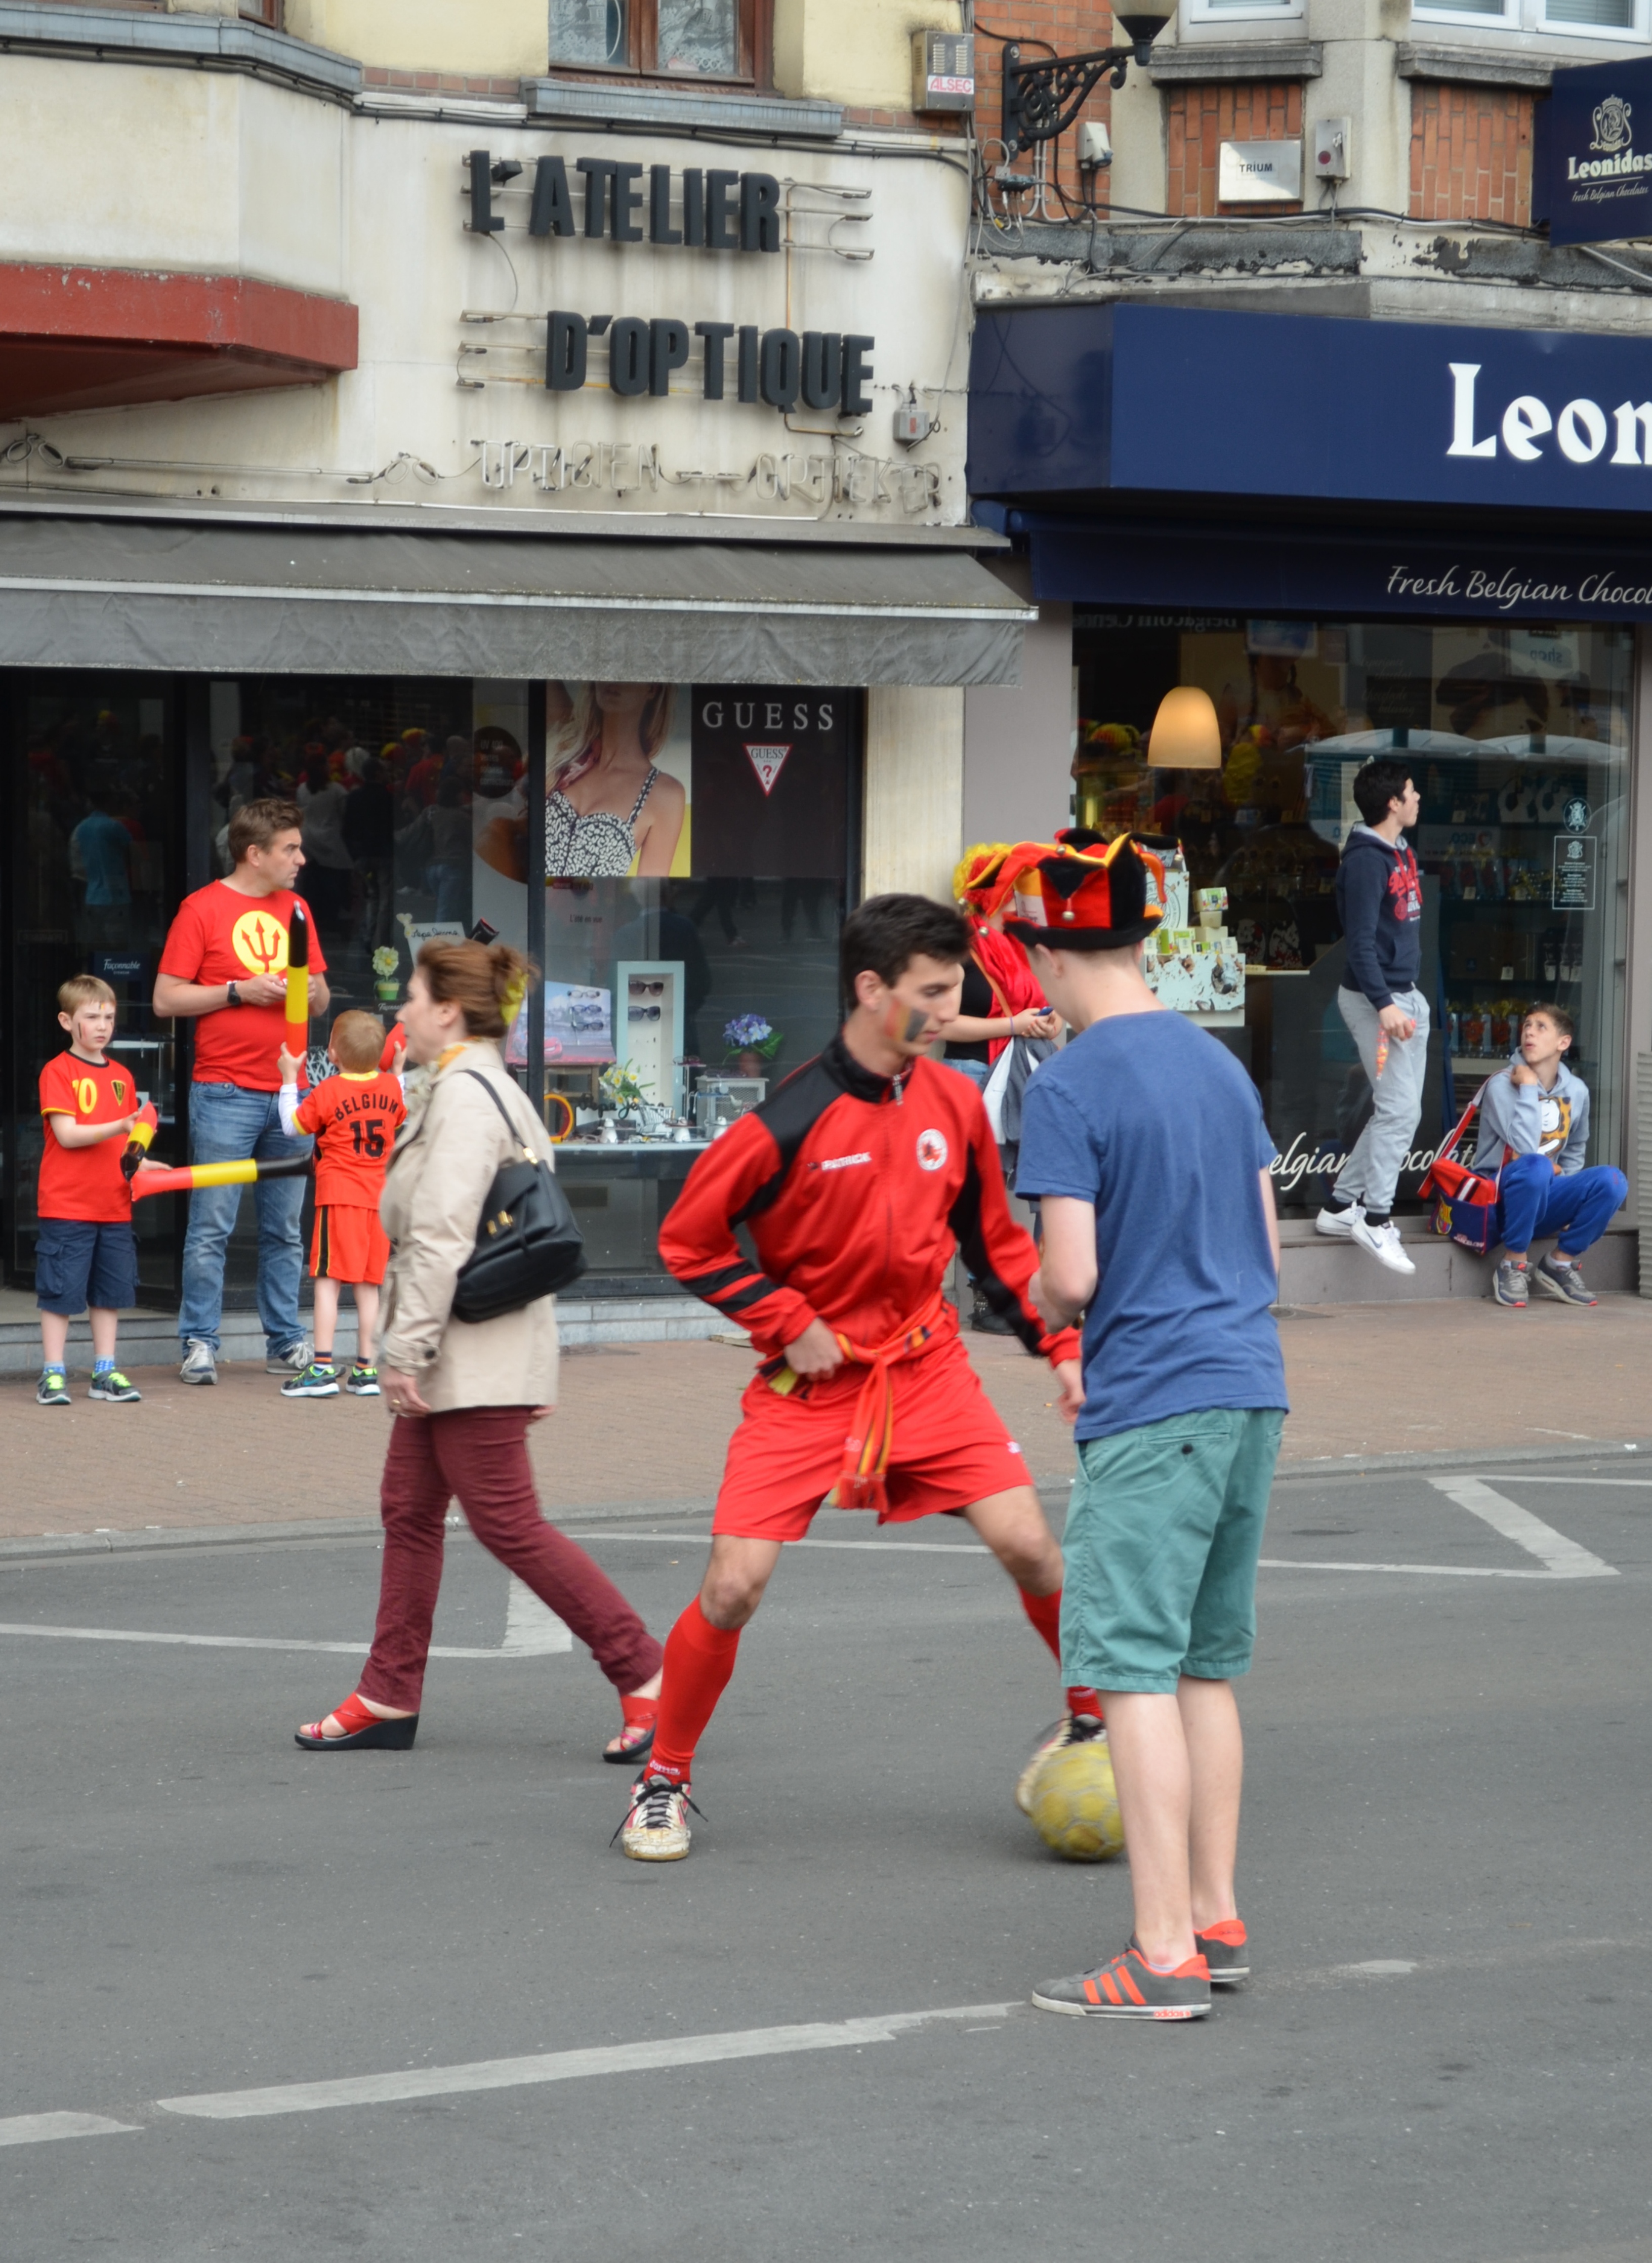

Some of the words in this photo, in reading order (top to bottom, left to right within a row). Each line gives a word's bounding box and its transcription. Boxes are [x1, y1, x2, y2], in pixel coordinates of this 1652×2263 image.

[928, 77, 973, 93] ALSEC
[1568, 148, 1652, 179] Leonidas
[470, 150, 780, 253] L'ATELIER
[1572, 189, 1589, 202] Fresh
[1590, 186, 1615, 203] Belgian
[1616, 181, 1649, 198] Chocolates
[546, 310, 875, 416] D'OPTIQUE
[1387, 564, 1460, 596] Fresh
[1466, 566, 1573, 610] Belgian
[702, 702, 834, 731] GUESS
[751, 748, 783, 759] GUESS
[349, 1119, 386, 1160] 15
